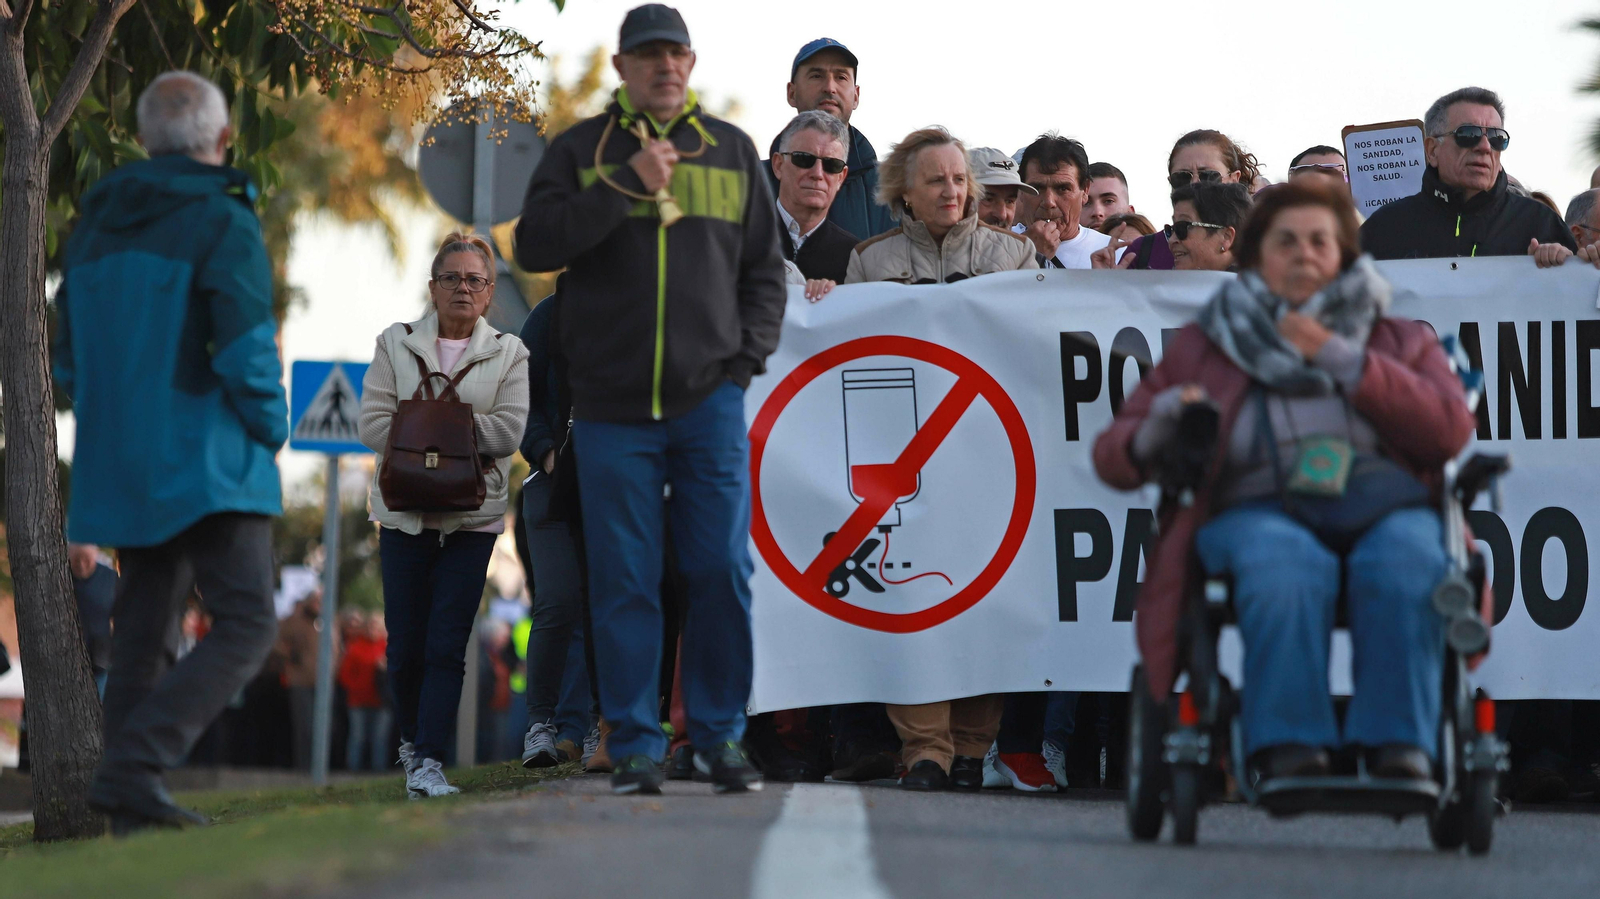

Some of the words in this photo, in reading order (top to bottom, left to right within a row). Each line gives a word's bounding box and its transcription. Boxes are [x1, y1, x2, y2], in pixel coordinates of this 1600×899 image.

[1354, 141, 1372, 149] NOS
[1374, 137, 1404, 147] ROBAN
[1362, 148, 1404, 160] SANIDAD,
[1357, 164, 1375, 172] NOS
[1377, 161, 1406, 170] ROBAN
[1372, 172, 1403, 182] SALUD.
[1060, 326, 1182, 441] PO
